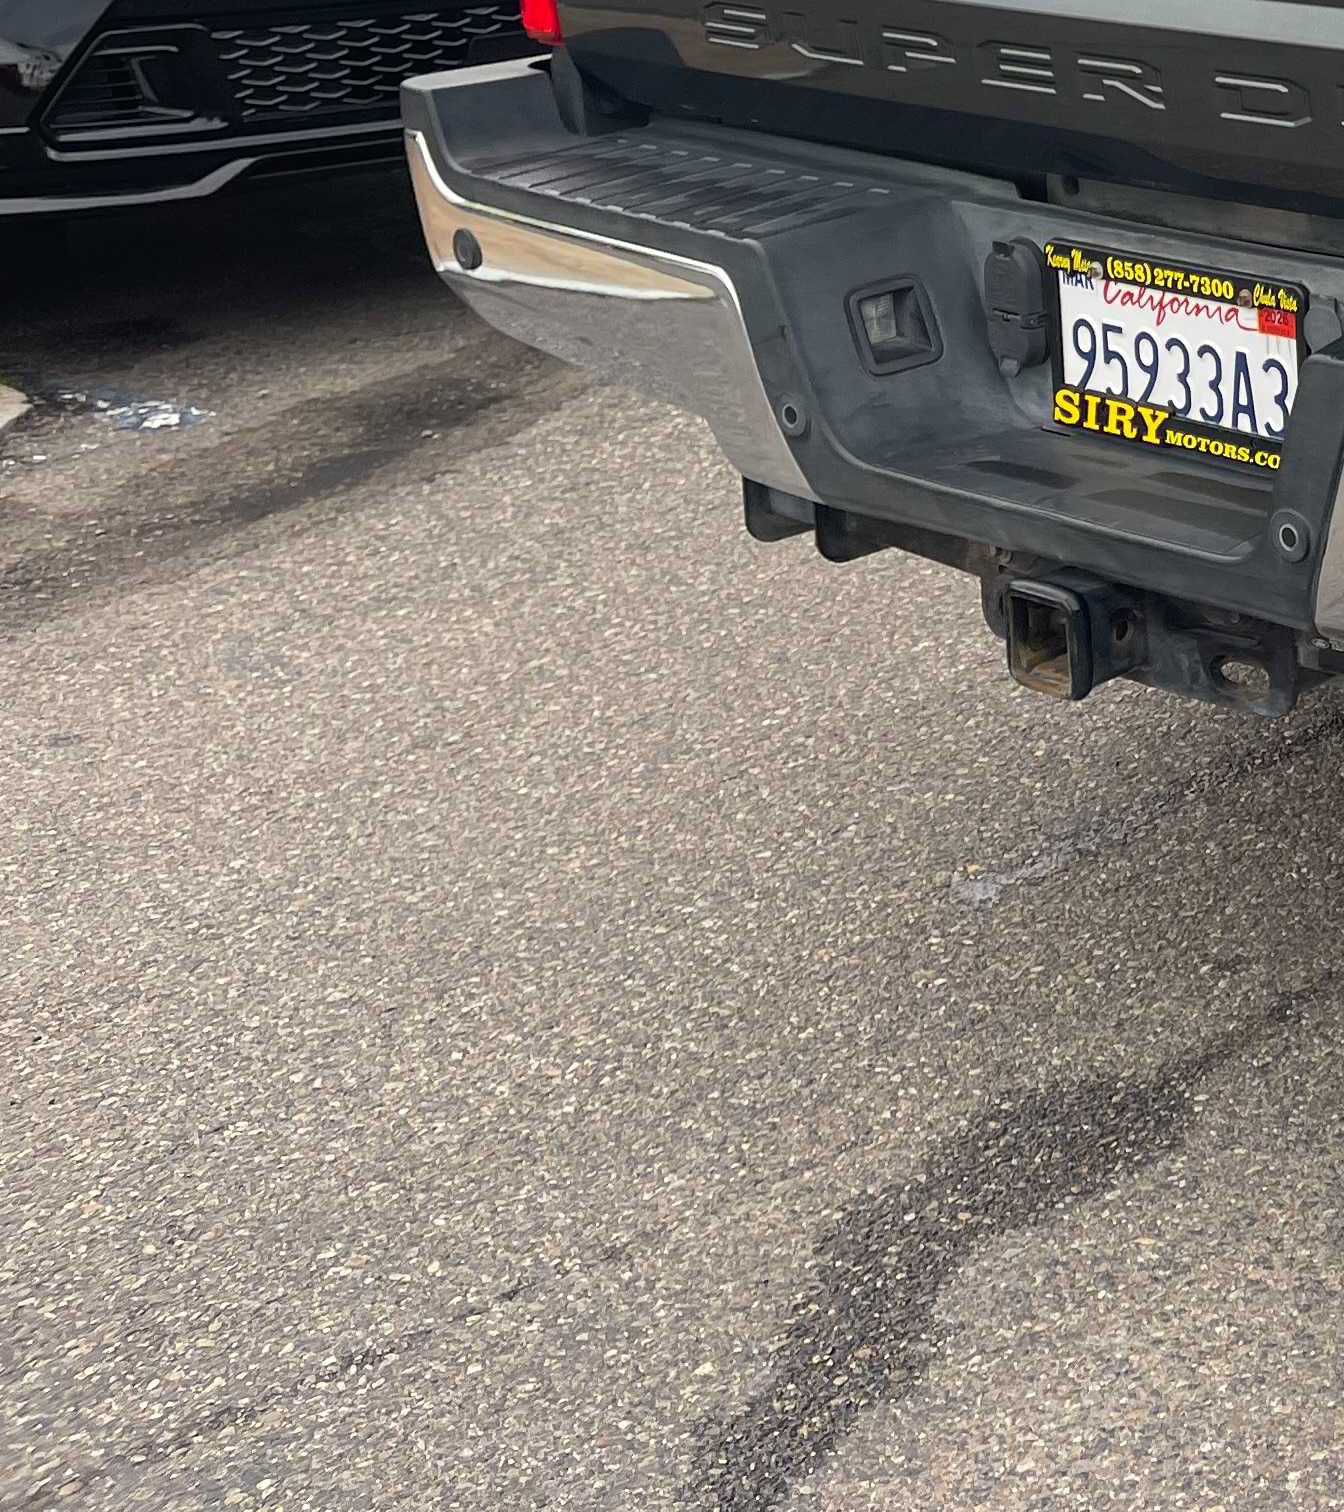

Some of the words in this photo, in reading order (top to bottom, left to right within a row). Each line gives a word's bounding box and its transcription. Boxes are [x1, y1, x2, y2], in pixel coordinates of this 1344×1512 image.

[705, 0, 1166, 110] SUPER
[1103, 279, 1258, 331] California
[1106, 256, 1152, 286] (858)
[1154, 267, 1234, 300] 277-7300
[1072, 317, 1290, 437] 95933A3
[1054, 387, 1169, 446] SIRY
